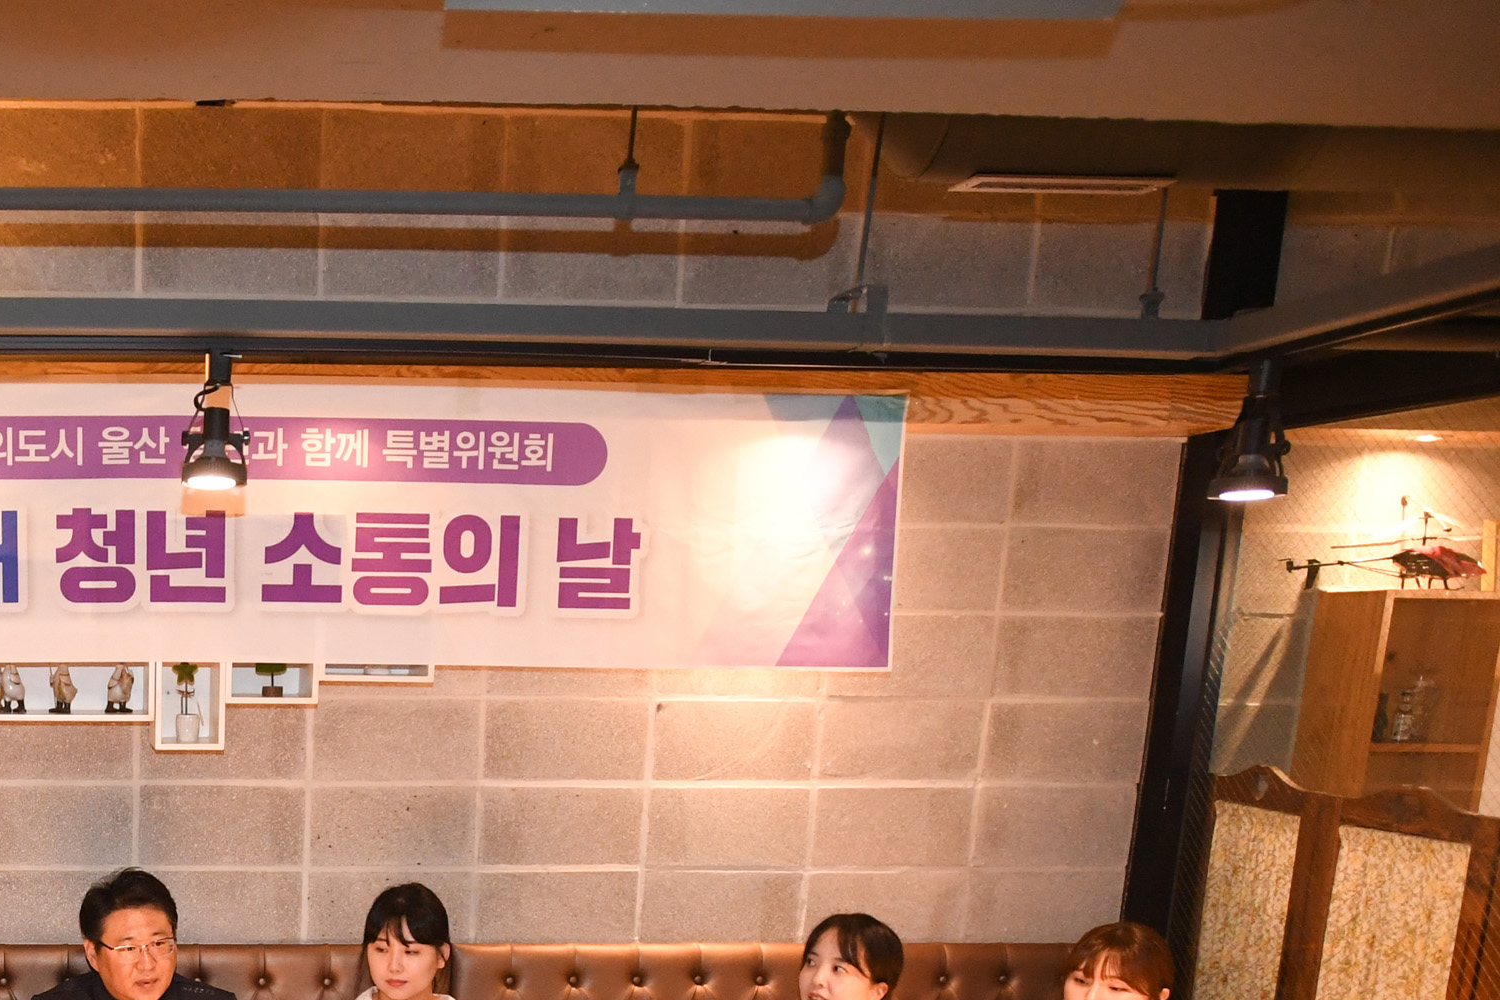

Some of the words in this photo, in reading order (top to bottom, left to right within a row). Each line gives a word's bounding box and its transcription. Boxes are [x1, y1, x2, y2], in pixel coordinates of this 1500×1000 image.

[98, 426, 170, 465] 울산
[300, 428, 369, 468] 함께
[382, 430, 554, 471] 특별위원회
[55, 507, 226, 603] 청년
[261, 512, 521, 607] 소통의
[556, 517, 642, 610] 날
